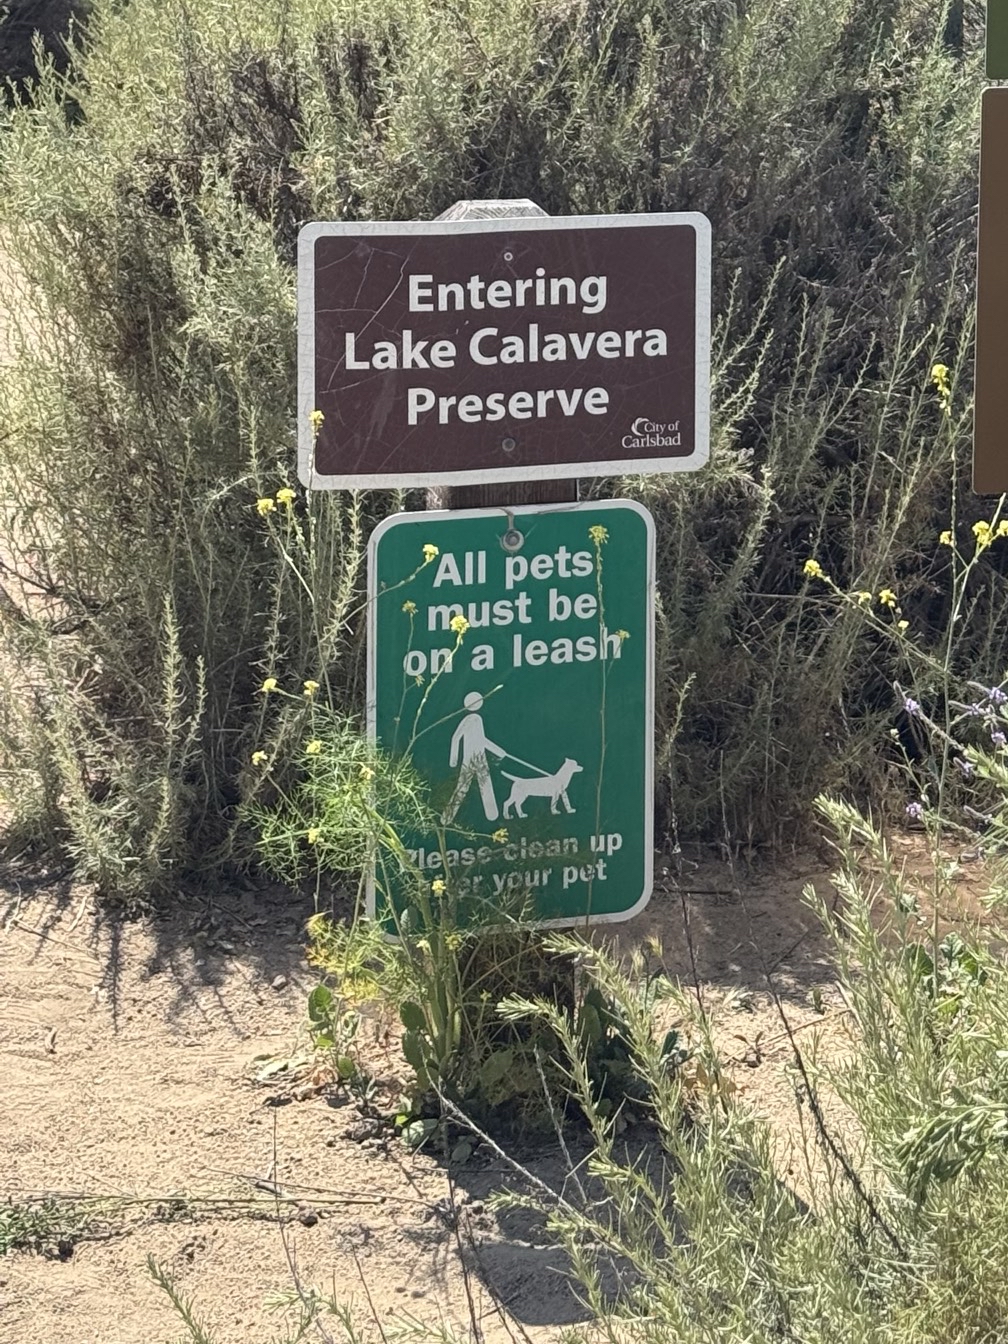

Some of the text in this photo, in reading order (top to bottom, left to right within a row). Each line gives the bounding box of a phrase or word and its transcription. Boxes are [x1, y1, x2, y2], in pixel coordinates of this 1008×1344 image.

[409, 267, 607, 314] Entering
[345, 323, 667, 370] Lake Calavera
[407, 386, 609, 426] Preserve
[621, 432, 681, 448] Carlsbad
[644, 420, 680, 434] City of
[432, 546, 593, 590] All pets
[428, 588, 597, 631] must be
[403, 626, 621, 677] on a leash
[590, 833, 623, 856] up
[563, 858, 607, 889] pet
